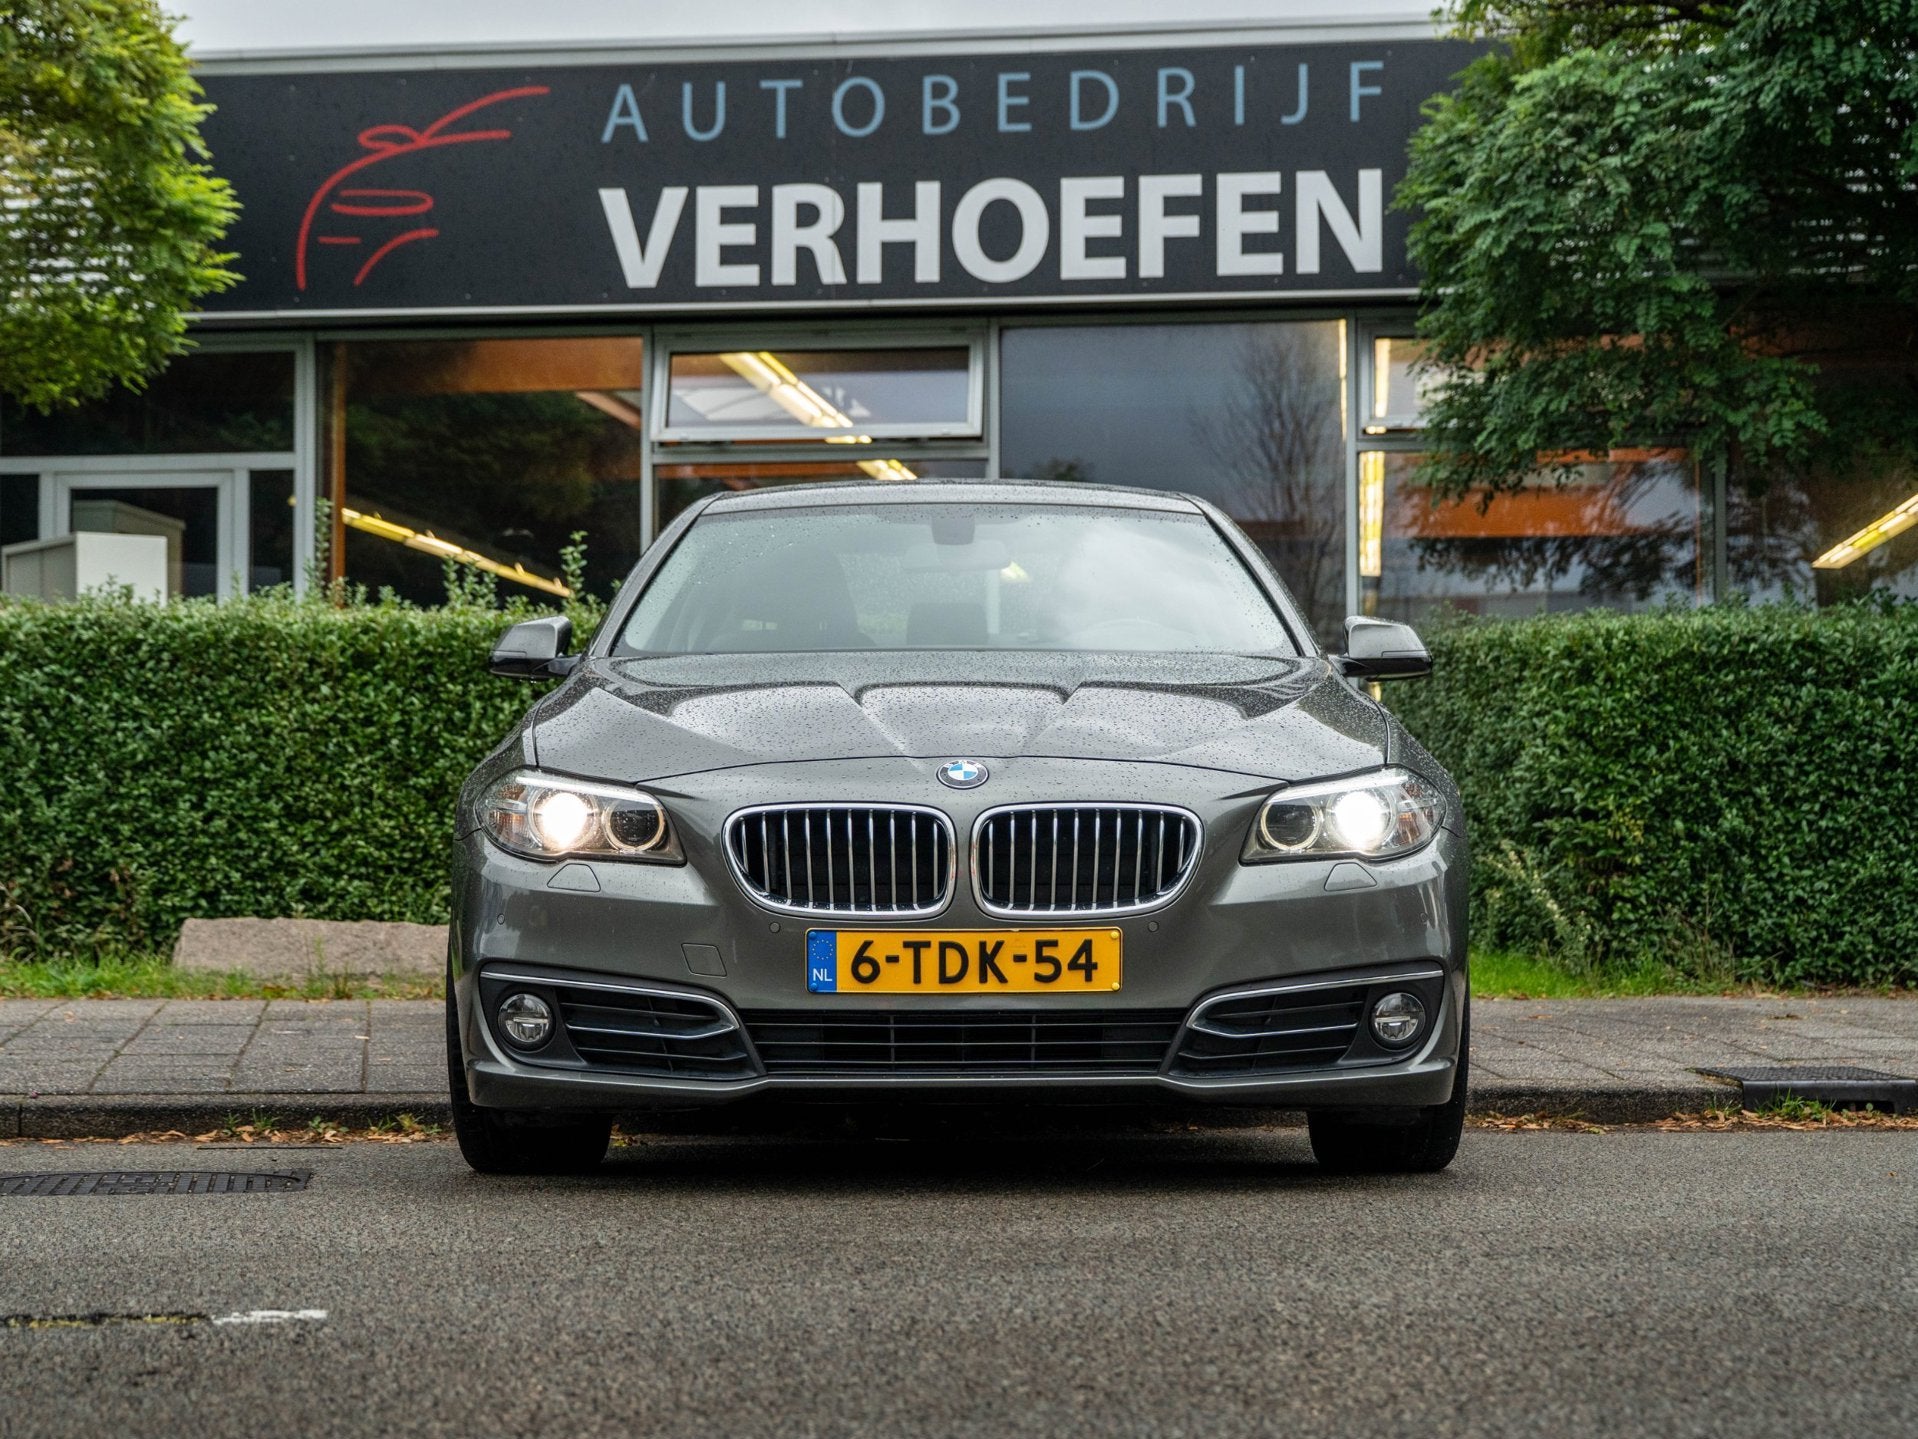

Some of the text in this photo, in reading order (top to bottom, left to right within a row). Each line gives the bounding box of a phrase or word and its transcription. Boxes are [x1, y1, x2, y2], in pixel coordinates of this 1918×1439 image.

[601, 61, 1384, 143] AUTOBEDRIJF
[599, 168, 1383, 288] VERHOEFEN
[813, 968, 832, 982] NL
[851, 939, 1098, 984] 6-TDK-54
